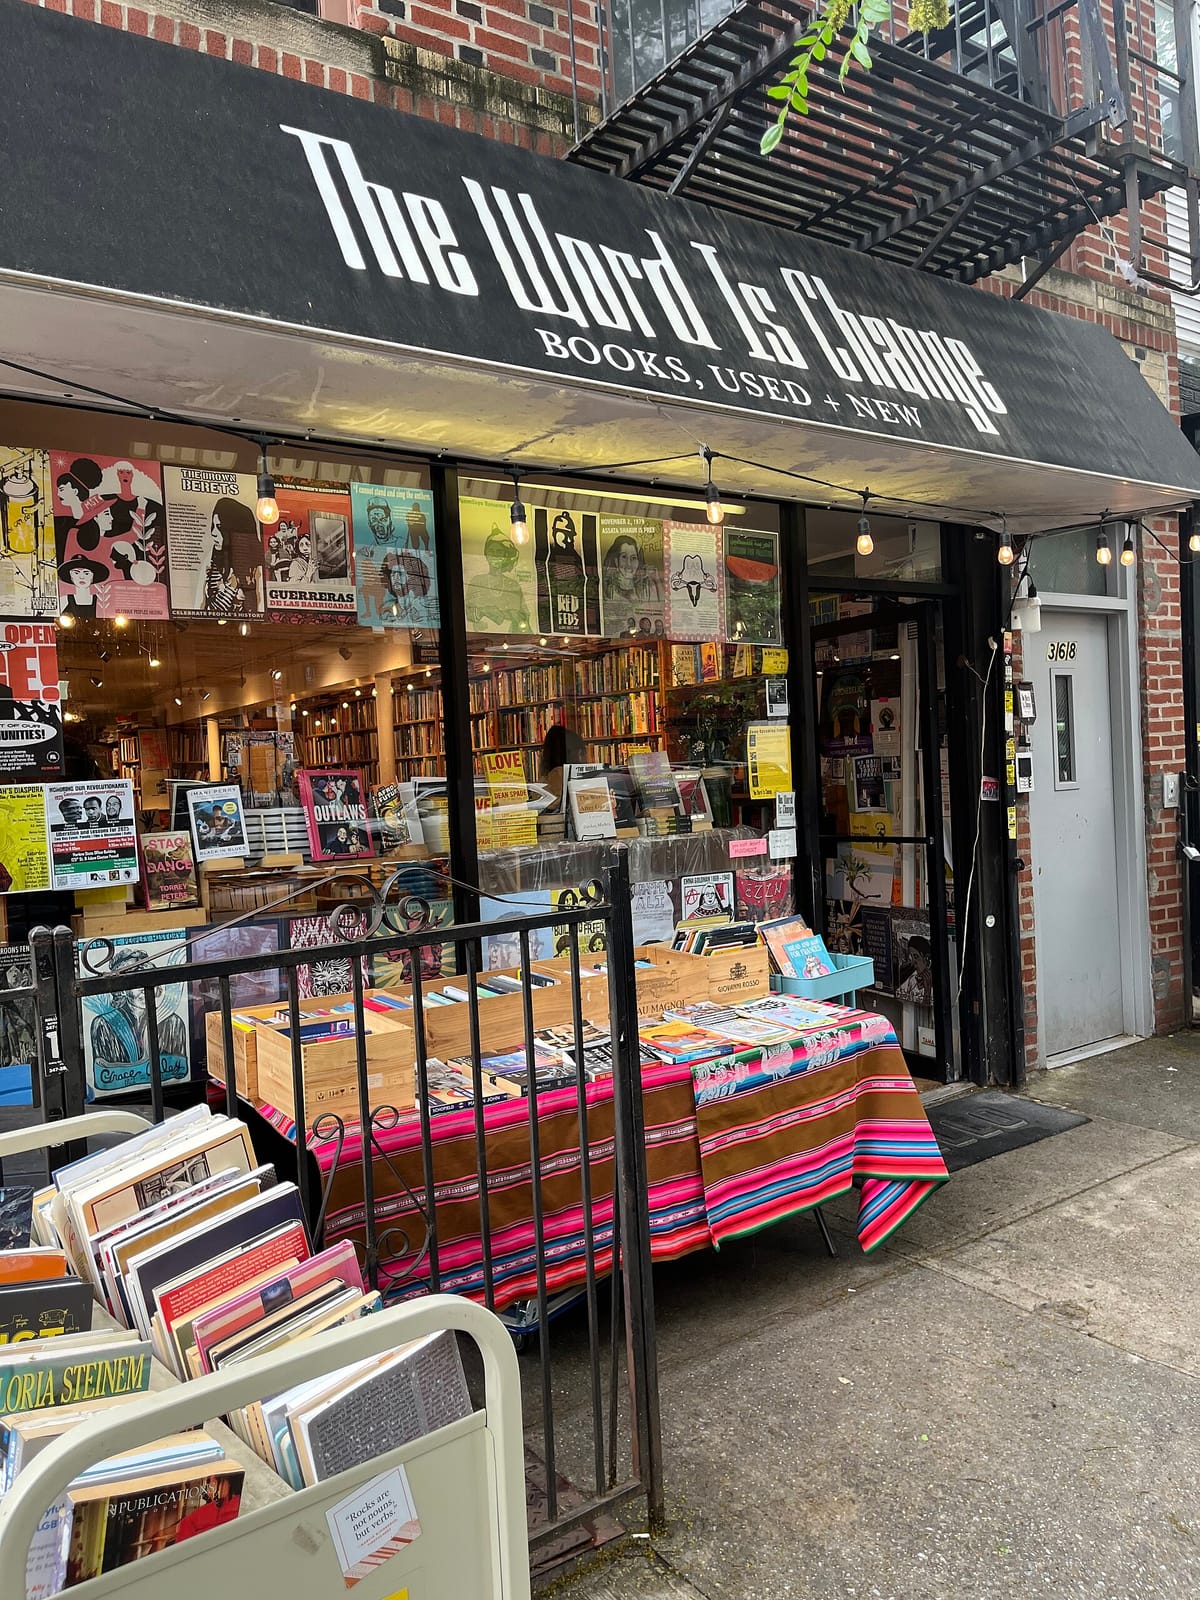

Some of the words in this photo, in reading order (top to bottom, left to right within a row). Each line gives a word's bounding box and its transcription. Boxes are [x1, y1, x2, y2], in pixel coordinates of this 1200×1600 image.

[280, 123, 479, 296] The
[461, 175, 722, 351] Word
[690, 243, 809, 371] Is
[780, 266, 1008, 436] Change
[534, 328, 705, 391] BOOKS,
[706, 364, 812, 406] USED
[823, 391, 841, 412] +
[852, 394, 922, 429] NEW
[181, 469, 200, 479] THE
[202, 471, 237, 482] BROWN
[182, 479, 239, 494] BERETS
[84, 495, 99, 510] MST
[269, 589, 354, 602] GUERRERAS
[301, 602, 355, 610] BARRICADAS
[5, 624, 56, 644] OPEN
[0, 646, 60, 702] E!
[487, 752, 522, 770] LOVE
[15, 786, 44, 794] DIASPORA
[377, 784, 394, 796] AFRO
[510, 790, 527, 798] SPADE
[476, 798, 491, 810] VE
[314, 804, 366, 822] OUTLAWS
[148, 838, 186, 851] STAG
[147, 860, 193, 874] DANCE
[160, 884, 187, 892] TORREY
[162, 892, 188, 900] PETERS
[636, 894, 665, 910] ALI
[554, 925, 569, 936] BUIL
[717, 982, 741, 993] GIOVANNI
[742, 979, 760, 989] ROSSO
[101, 1069, 142, 1084] Grace
[432, 1104, 454, 1113] SCHOFIELD
[0, 1369, 55, 1413] LORIA
[61, 1353, 145, 1403] STEINEM
[118, 1484, 216, 1513] PUBLICATIONS
[376, 1490, 389, 1503] are
[352, 1518, 367, 1531] not
[368, 1500, 395, 1524] nouns,
[355, 1528, 370, 1541] but
